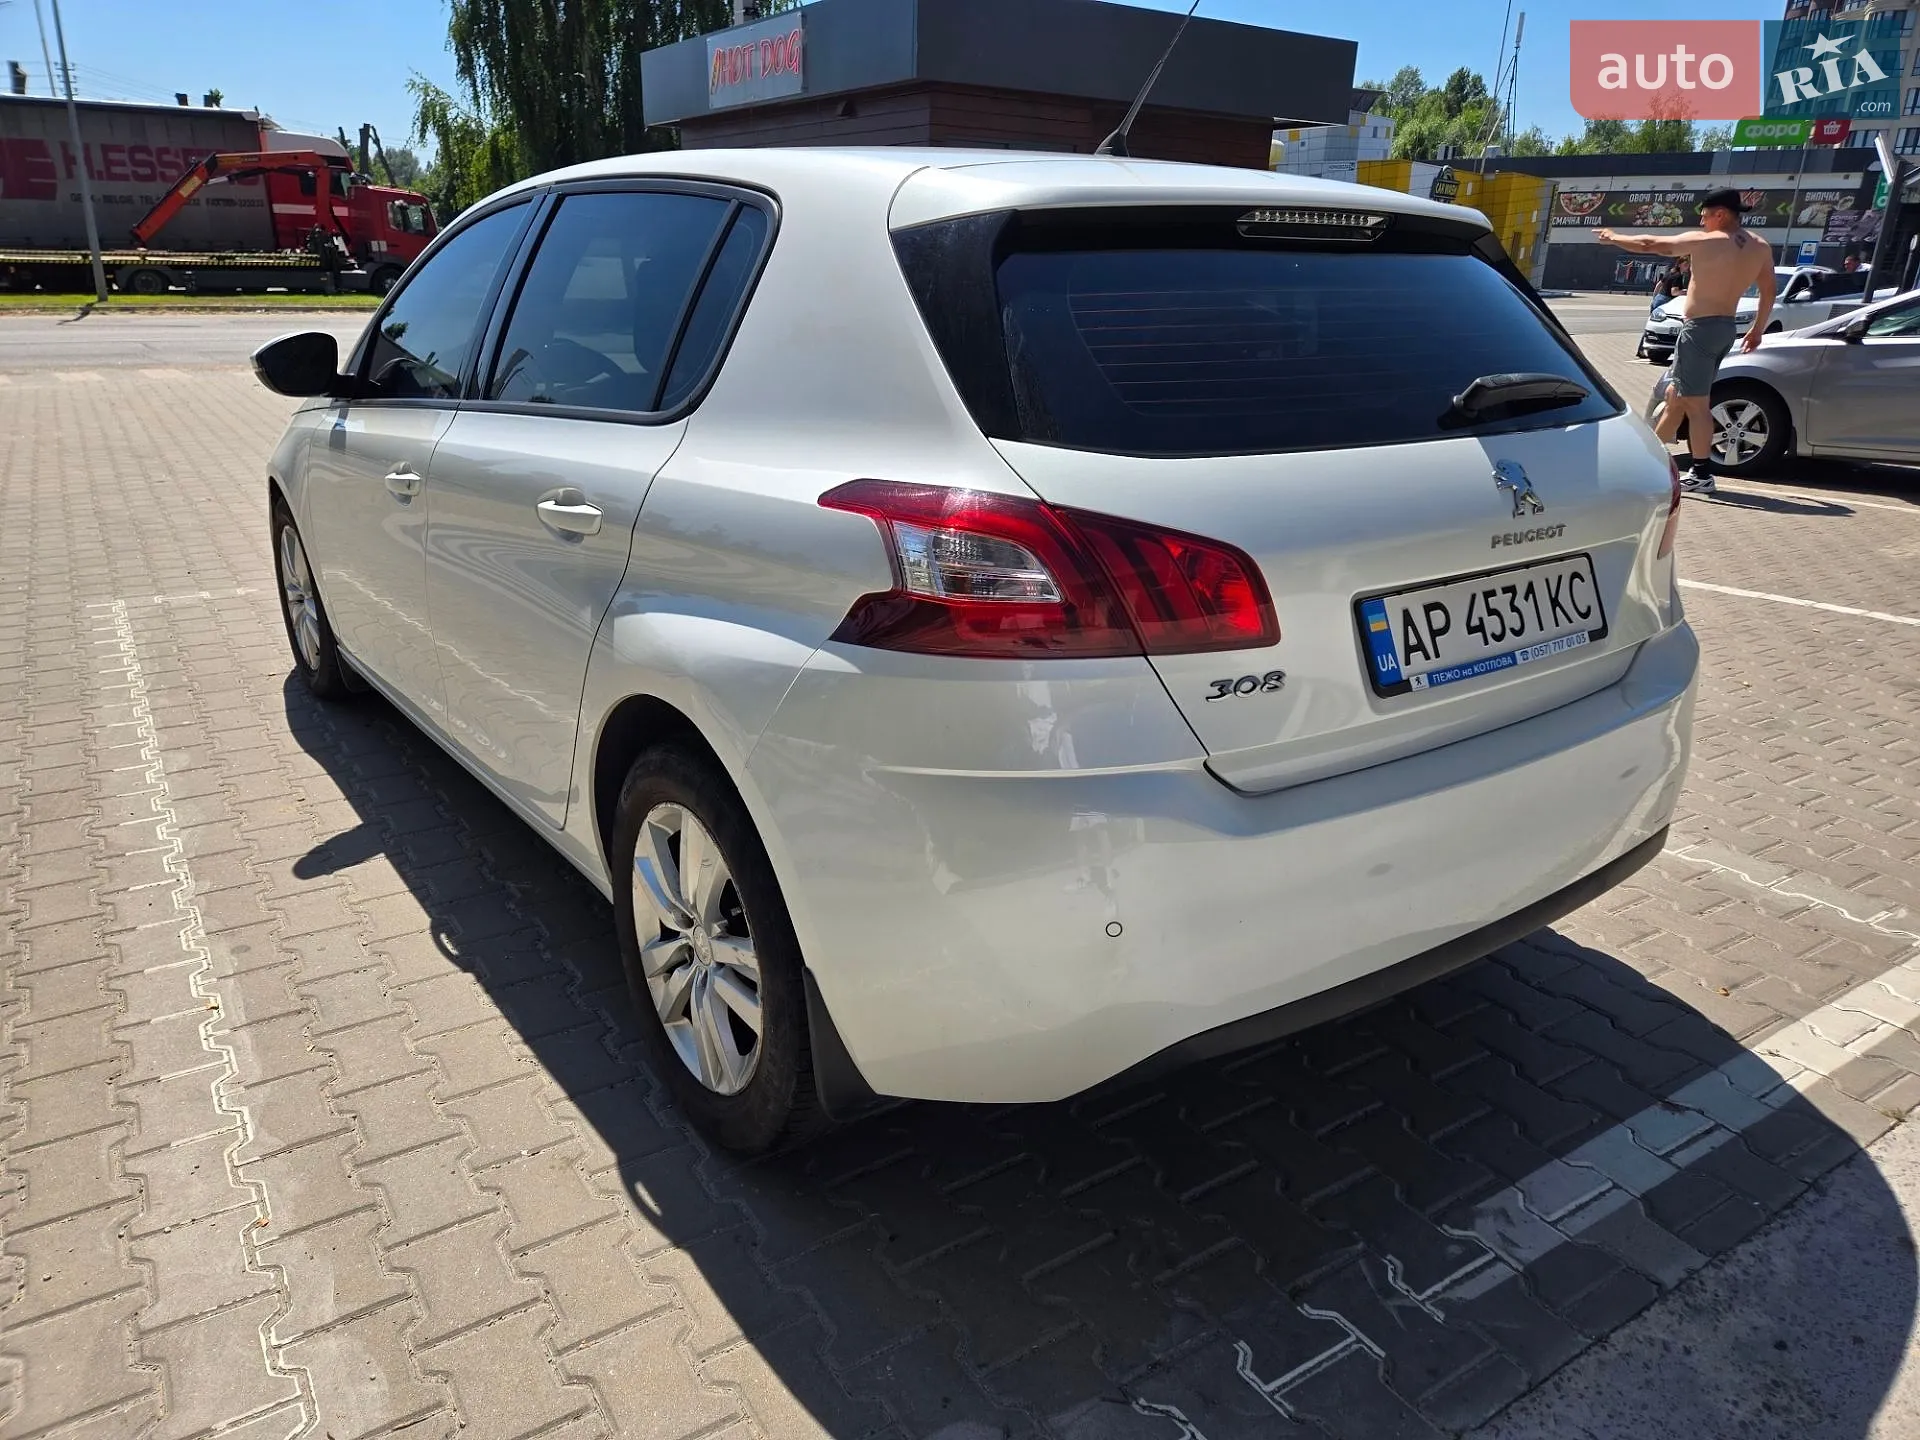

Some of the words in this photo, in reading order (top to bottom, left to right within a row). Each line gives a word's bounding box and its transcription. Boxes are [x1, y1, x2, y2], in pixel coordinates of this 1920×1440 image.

[719, 43, 755, 86] HOT
[760, 29, 800, 79] DOG
[1629, 193, 1651, 203] ОВОЧІ
[1654, 193, 1663, 202] ТА
[1665, 192, 1695, 202] ФРУКТИ
[1805, 191, 1840, 202] ВИПІЧКА
[1552, 215, 1581, 225] СМАЧНА
[1584, 215, 1602, 226] ПІЦА
[1490, 523, 1567, 549] PEUGEOT
[1402, 601, 1451, 667] AP
[1465, 580, 1545, 647] 4531
[1545, 571, 1592, 628] KC
[1377, 652, 1398, 672] UA
[1432, 669, 1461, 684] ПЕЖО
[1473, 655, 1513, 673] КОТЛОВА
[1552, 638, 1565, 652] 717
[1205, 670, 1287, 702] 308
